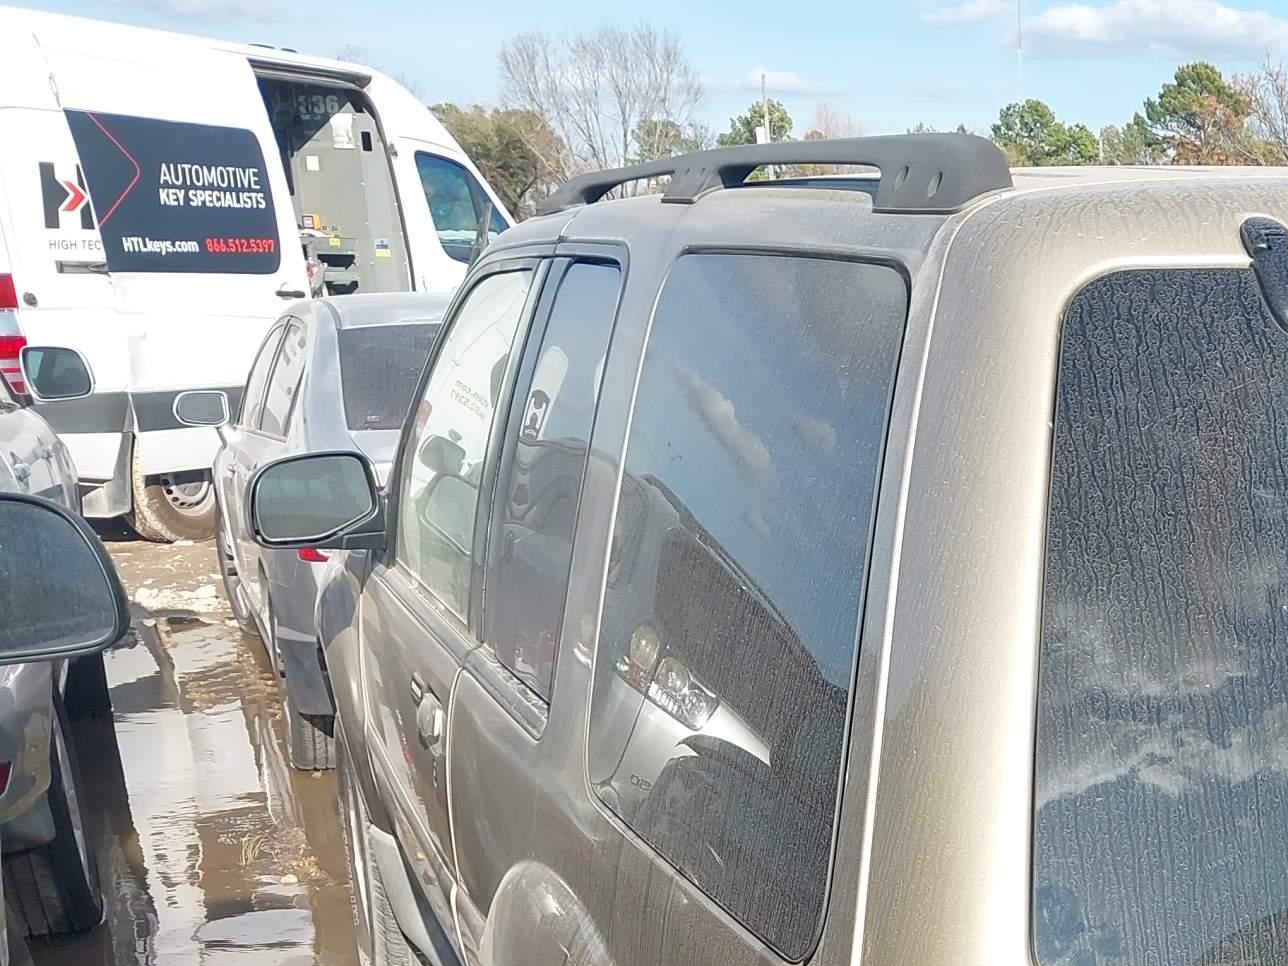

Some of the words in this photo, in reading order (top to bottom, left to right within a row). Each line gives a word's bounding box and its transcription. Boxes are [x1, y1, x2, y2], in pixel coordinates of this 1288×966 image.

[160, 163, 260, 190] AUTOMOTIVE
[159, 188, 185, 207] KEY
[189, 190, 266, 209] SPECIALISTS
[49, 239, 78, 250] HIGH
[122, 236, 199, 256] HTLkeys.com
[206, 238, 275, 254] 866.512.5397
